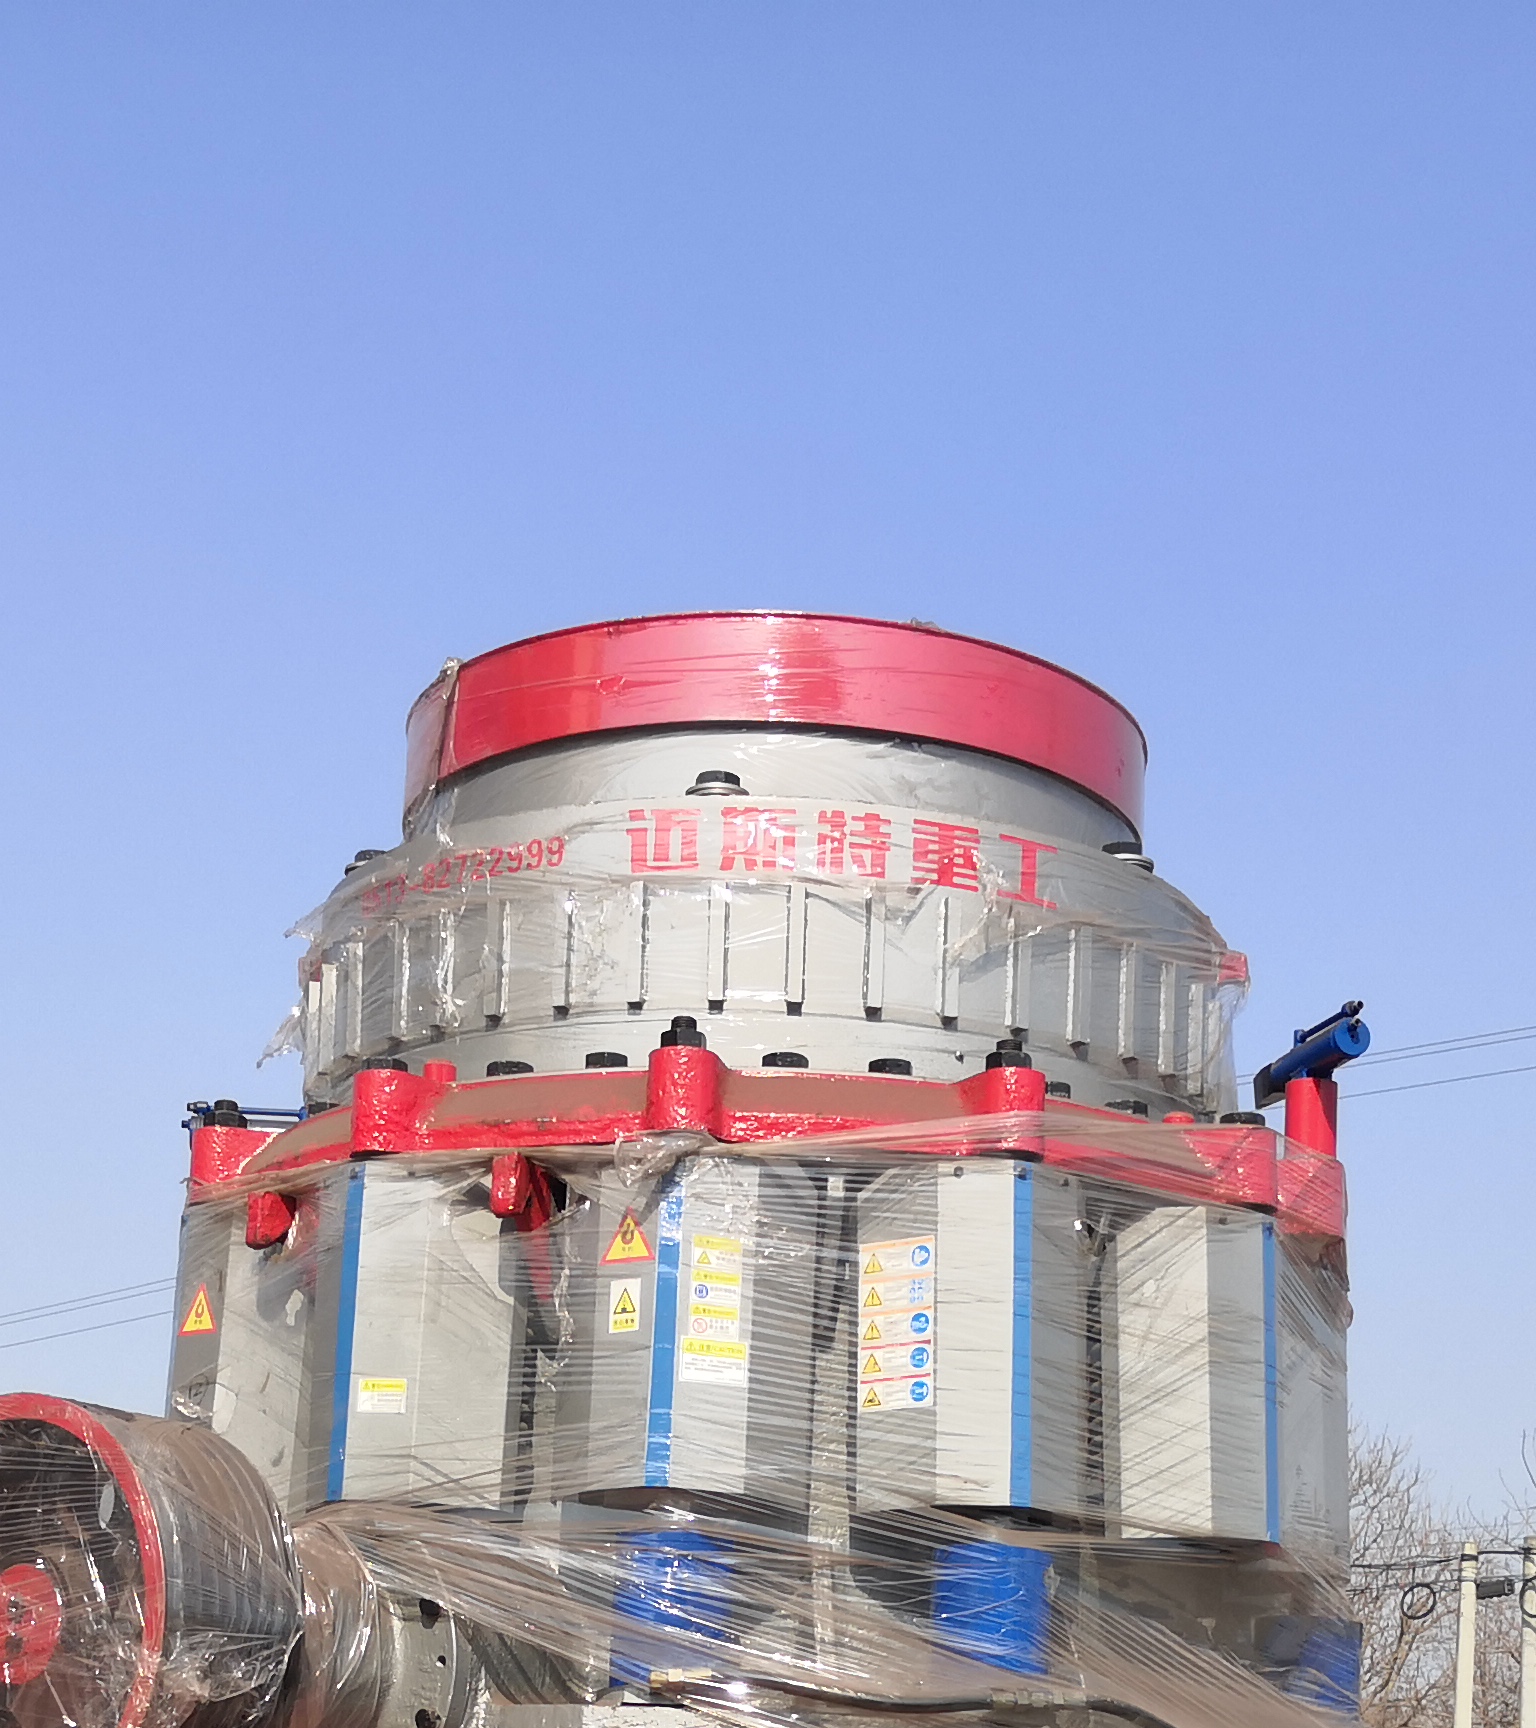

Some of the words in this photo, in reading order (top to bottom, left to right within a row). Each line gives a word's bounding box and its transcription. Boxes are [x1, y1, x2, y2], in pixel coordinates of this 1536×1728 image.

[625, 806, 1059, 910] 迈斯特重工
